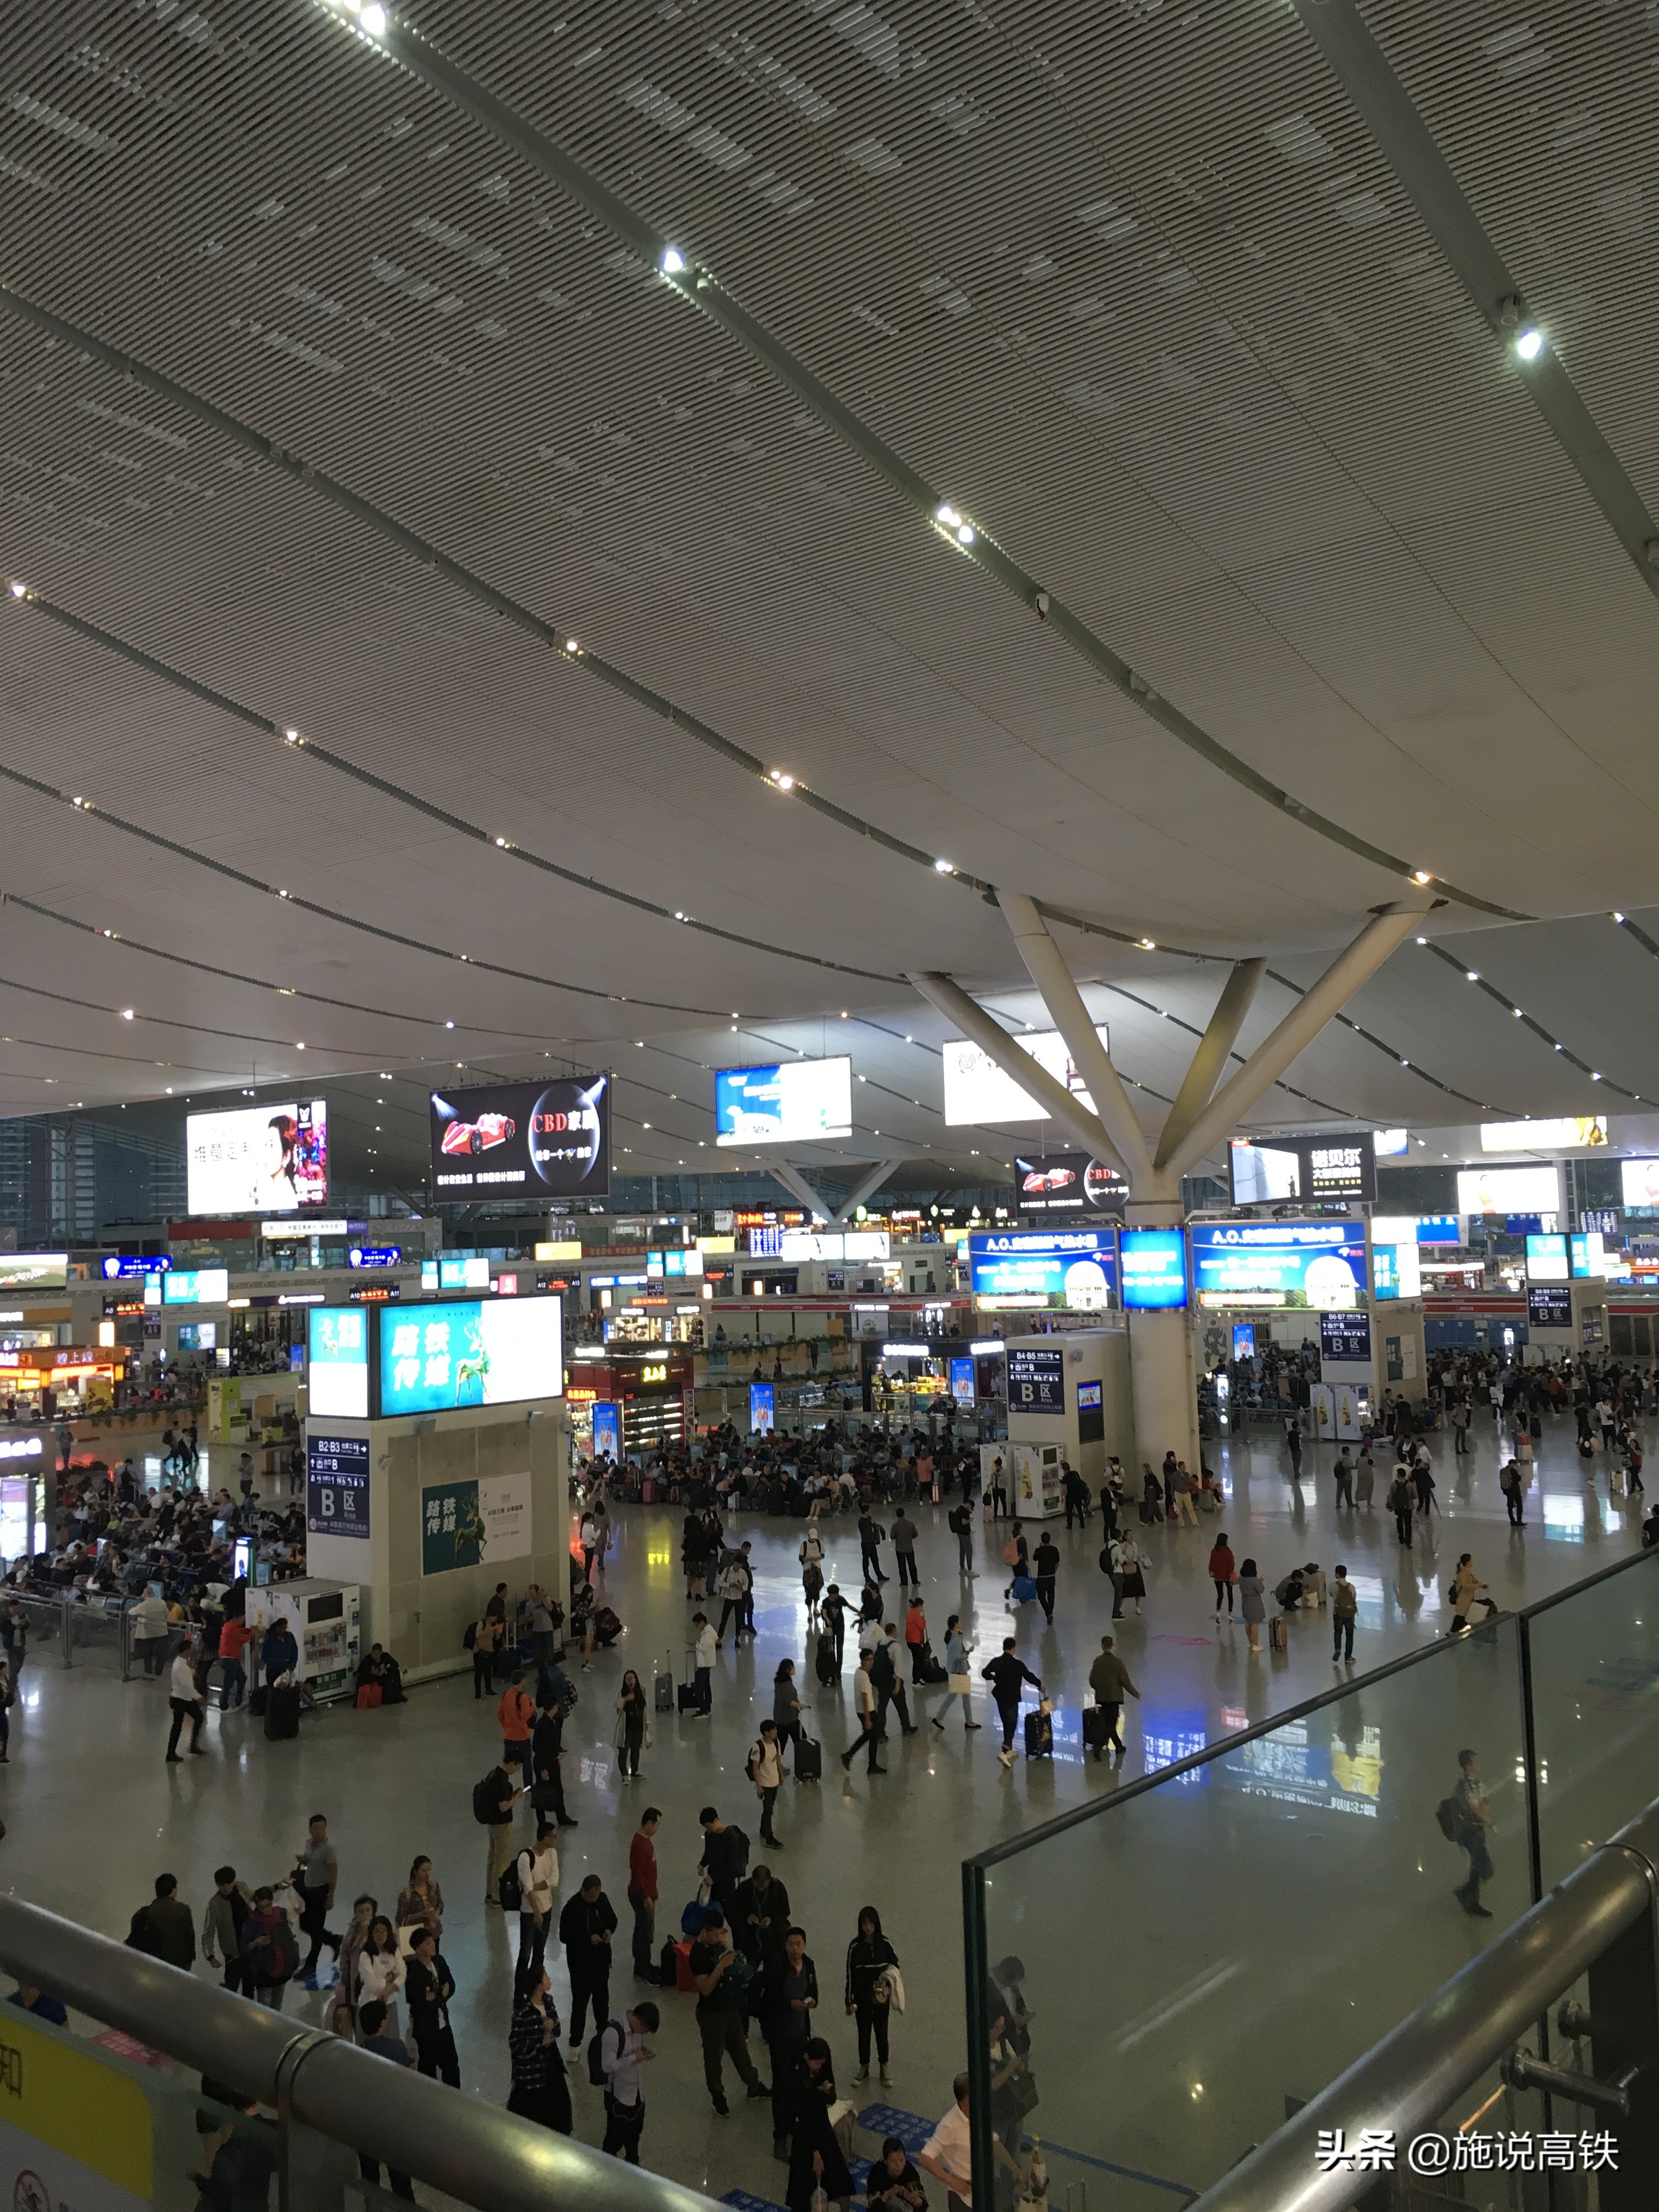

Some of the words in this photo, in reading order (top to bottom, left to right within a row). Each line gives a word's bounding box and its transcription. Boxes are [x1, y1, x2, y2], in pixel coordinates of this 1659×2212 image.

[1312, 1148, 1361, 1168] 诺贝尔
[1539, 1308, 1549, 1320] B
[1333, 1338, 1344, 1352] B
[1350, 1338, 1360, 1348] 区
[1022, 1383, 1034, 1402] B
[1040, 1384, 1052, 1397] 区
[332, 1459, 338, 1470] B
[321, 1488, 335, 1516] B
[343, 1491, 356, 1511] 区
[426, 1497, 456, 1518] 路铁
[344, 1511, 356, 1520] Area
[427, 1514, 457, 1536] 传媒
